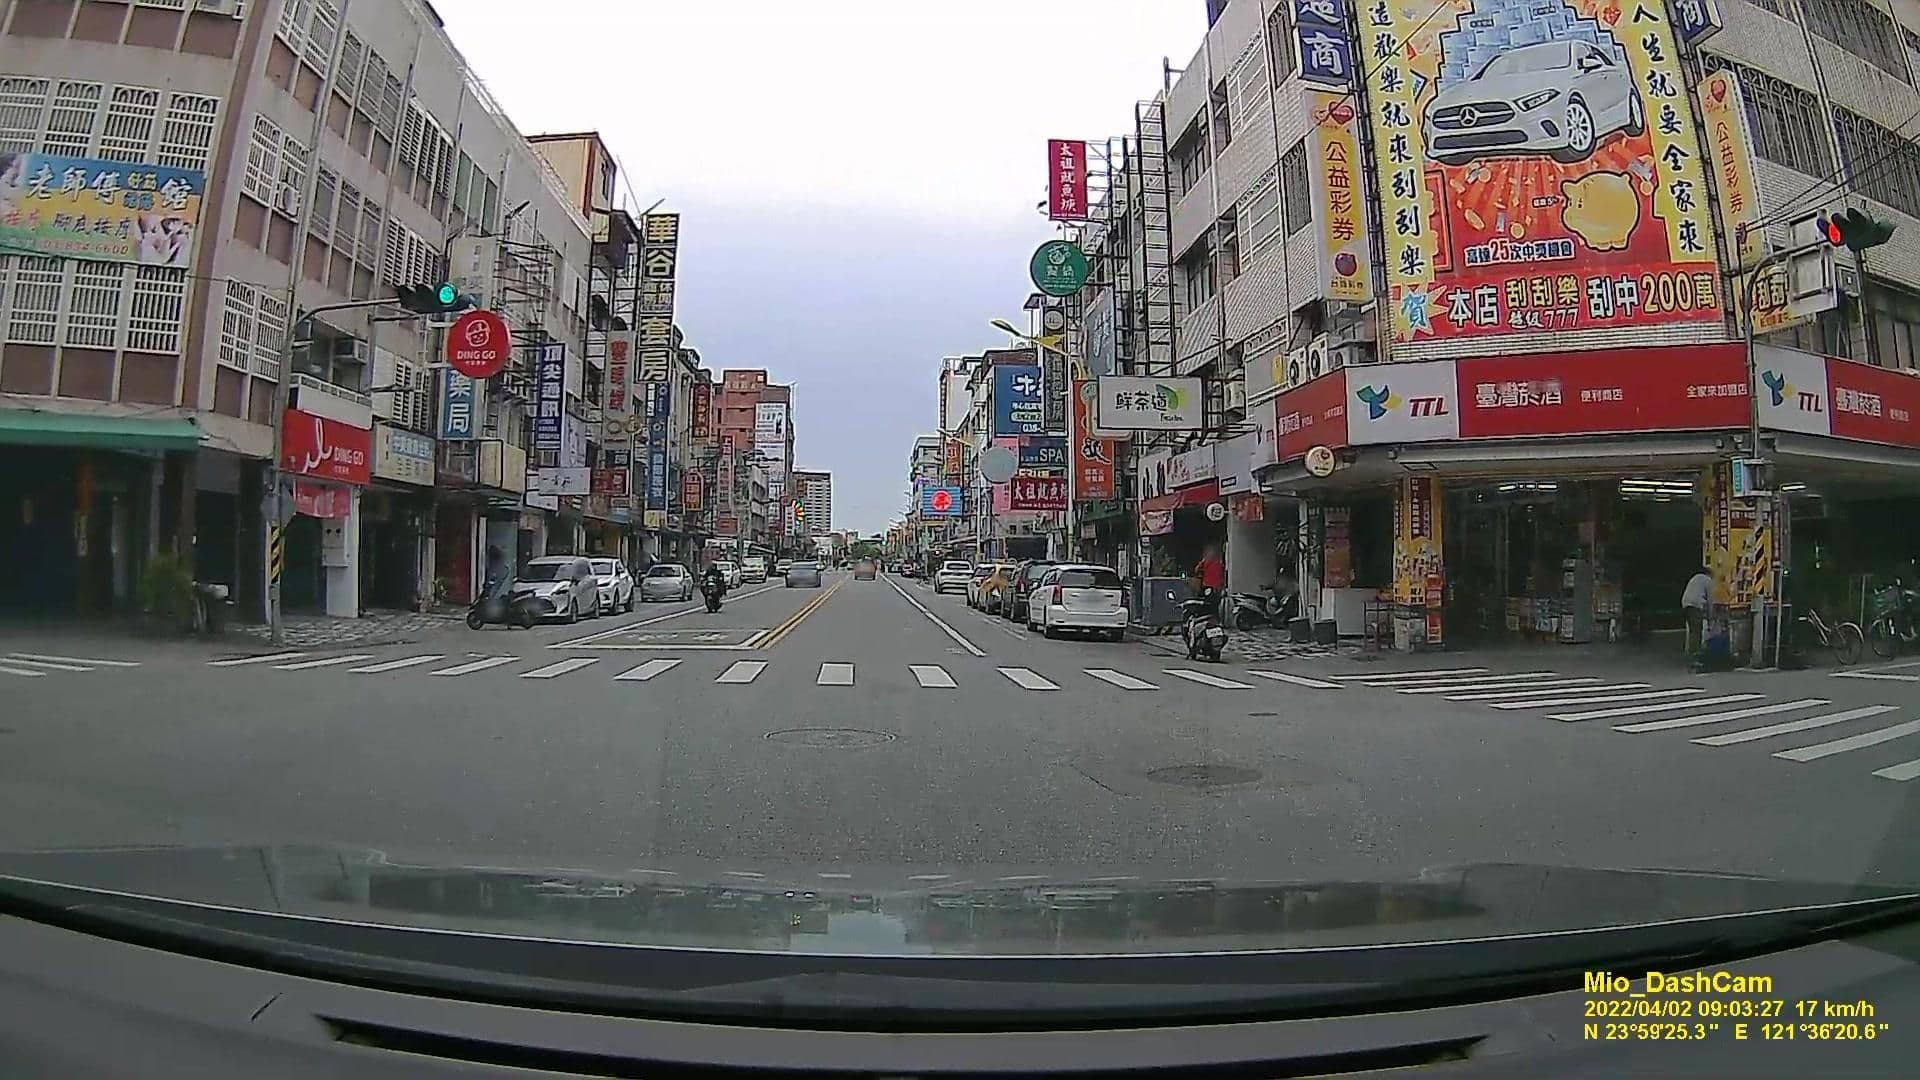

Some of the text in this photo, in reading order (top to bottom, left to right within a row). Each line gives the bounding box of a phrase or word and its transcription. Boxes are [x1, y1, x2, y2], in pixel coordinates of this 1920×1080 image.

[1632, 4, 1704, 253] 人生就要全家來
[1325, 140, 1354, 241] 公益彩券
[1401, 292, 1428, 328] 賀
[1448, 284, 1499, 328] 本店
[1505, 275, 1580, 309] 刮刮樂
[1586, 271, 1717, 319] 刮中200萬
[457, 350, 497, 360] DING GO
[1115, 390, 1168, 412] 鮮茶道
[1580, 388, 1623, 403] 便利商店
[1797, 391, 1824, 413] TTL
[1408, 397, 1450, 418] TTL
[334, 447, 364, 466] DING GO
[1039, 448, 1065, 462] SPA
